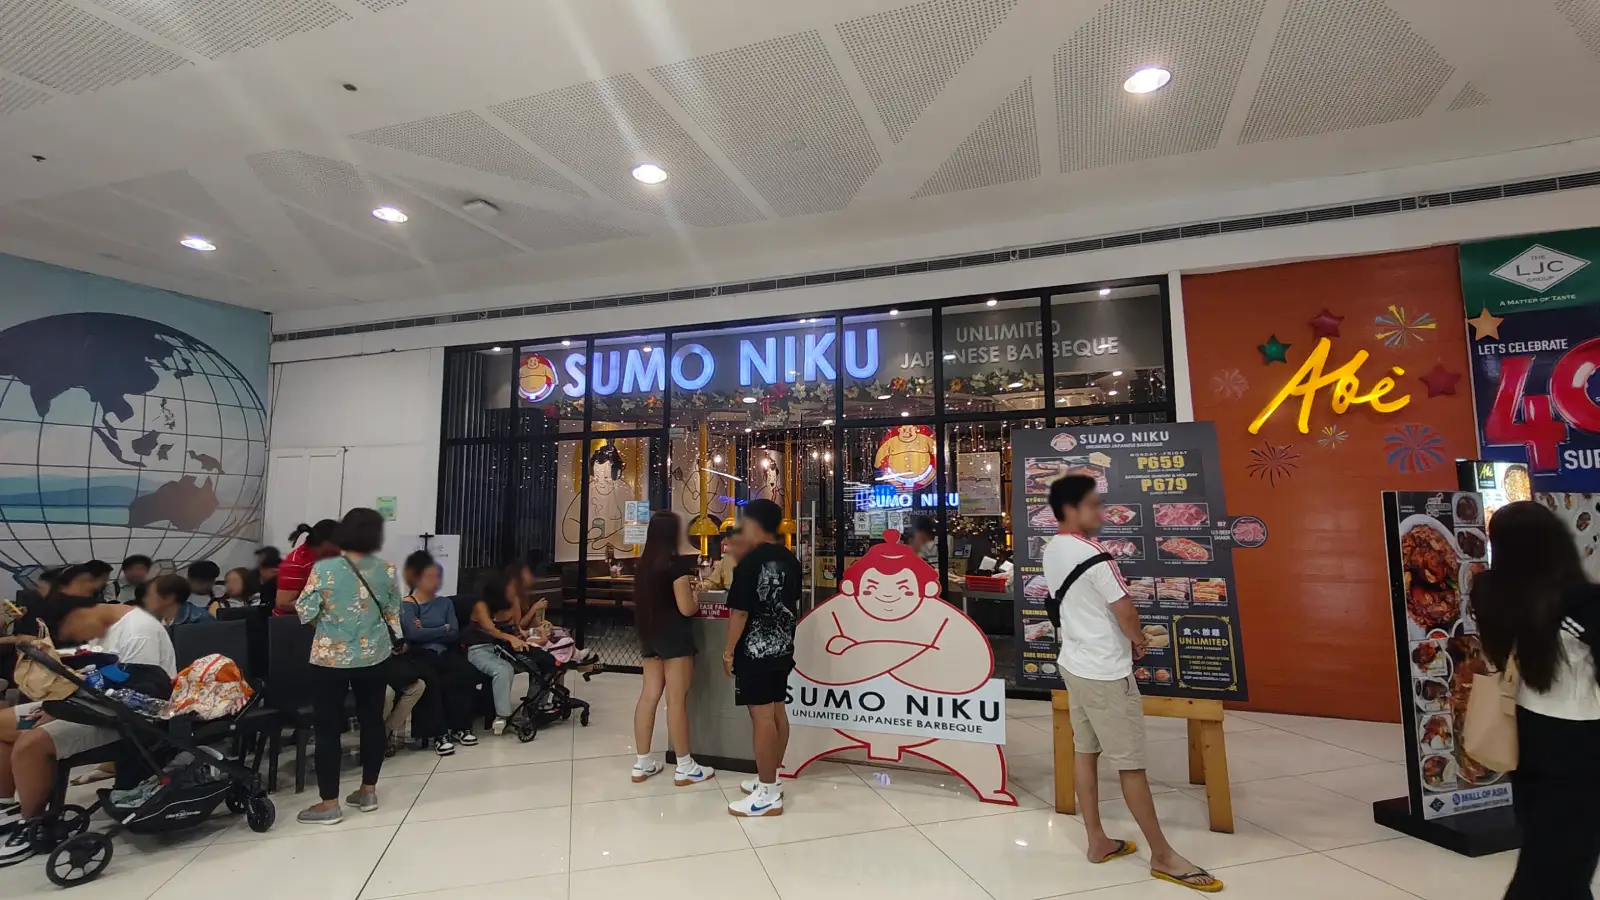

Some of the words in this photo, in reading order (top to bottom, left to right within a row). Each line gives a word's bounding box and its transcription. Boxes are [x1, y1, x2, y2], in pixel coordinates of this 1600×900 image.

[1515, 260, 1564, 277] LJC
[1526, 275, 1555, 283] GROUP
[1507, 297, 1538, 306] MATTER
[1540, 296, 1551, 304] OF
[1551, 294, 1577, 302] TASTE
[956, 320, 1061, 343] UNLIMITED
[1478, 343, 1506, 356] LET'S
[1508, 338, 1569, 354] CELEBRATE
[562, 343, 716, 398] SUMO
[738, 327, 880, 388] NIKU
[900, 345, 1000, 370] JAPNESE
[1080, 433, 1125, 445] SUMO
[1131, 431, 1170, 442] NIKU
[1137, 455, 1185, 470] P659
[1141, 478, 1188, 492] P679
[868, 493, 912, 507] SUMO
[920, 493, 960, 507] NIU
[1179, 637, 1229, 647] UNLIMITED
[784, 685, 886, 712] SUMO
[906, 694, 1000, 722] NIKU
[792, 709, 849, 722] UNLIMITED
[853, 715, 913, 728] JAPANESE
[916, 720, 983, 734] BARBEQUE
